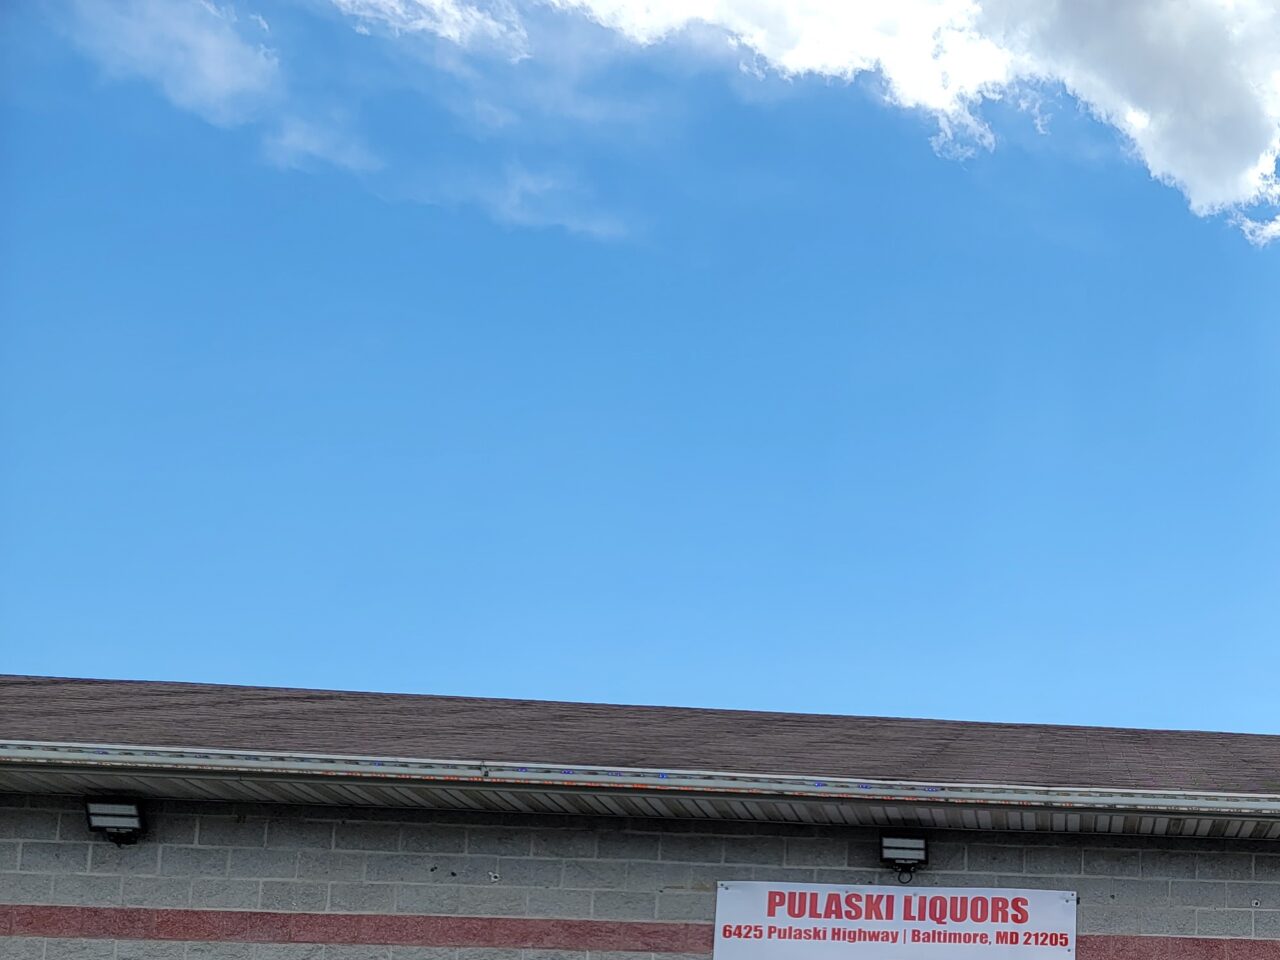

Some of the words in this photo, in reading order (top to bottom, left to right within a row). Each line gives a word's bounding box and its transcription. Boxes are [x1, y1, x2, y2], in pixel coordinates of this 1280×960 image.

[767, 891, 895, 920] PULASKI
[903, 895, 1029, 925] LIQUORS
[722, 925, 763, 939] 6425
[767, 926, 827, 941] Pulaski
[831, 928, 899, 943] Highway
[911, 929, 992, 946] Baltimore,
[996, 931, 1019, 945] MD
[1023, 932, 1068, 947] 21205
